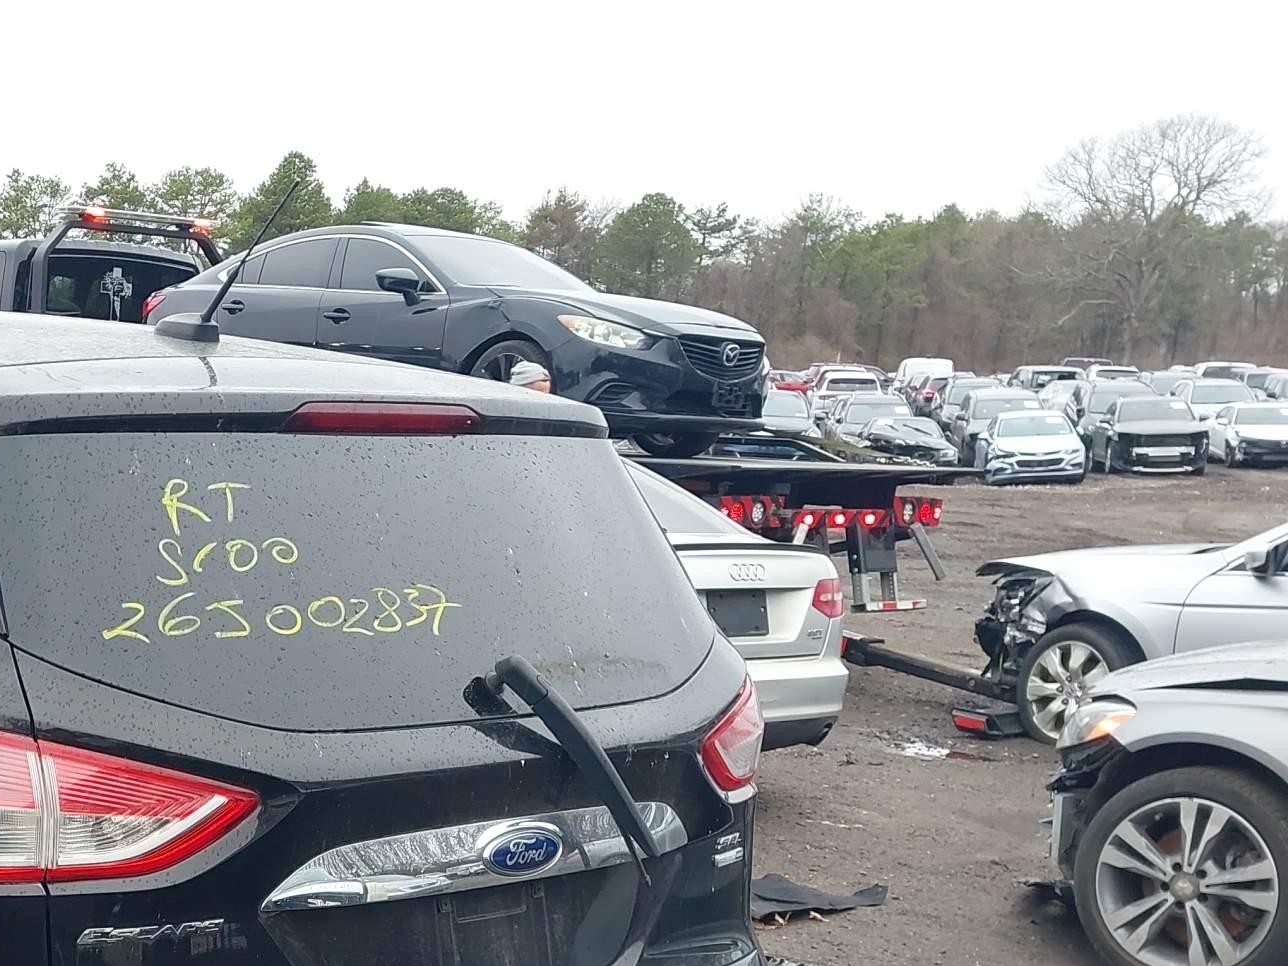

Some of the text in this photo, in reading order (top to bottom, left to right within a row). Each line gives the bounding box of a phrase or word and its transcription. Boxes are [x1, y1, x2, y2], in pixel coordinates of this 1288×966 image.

[161, 478, 252, 536] RT
[505, 837, 547, 866] Ford
[76, 918, 225, 945] ESCAPE
